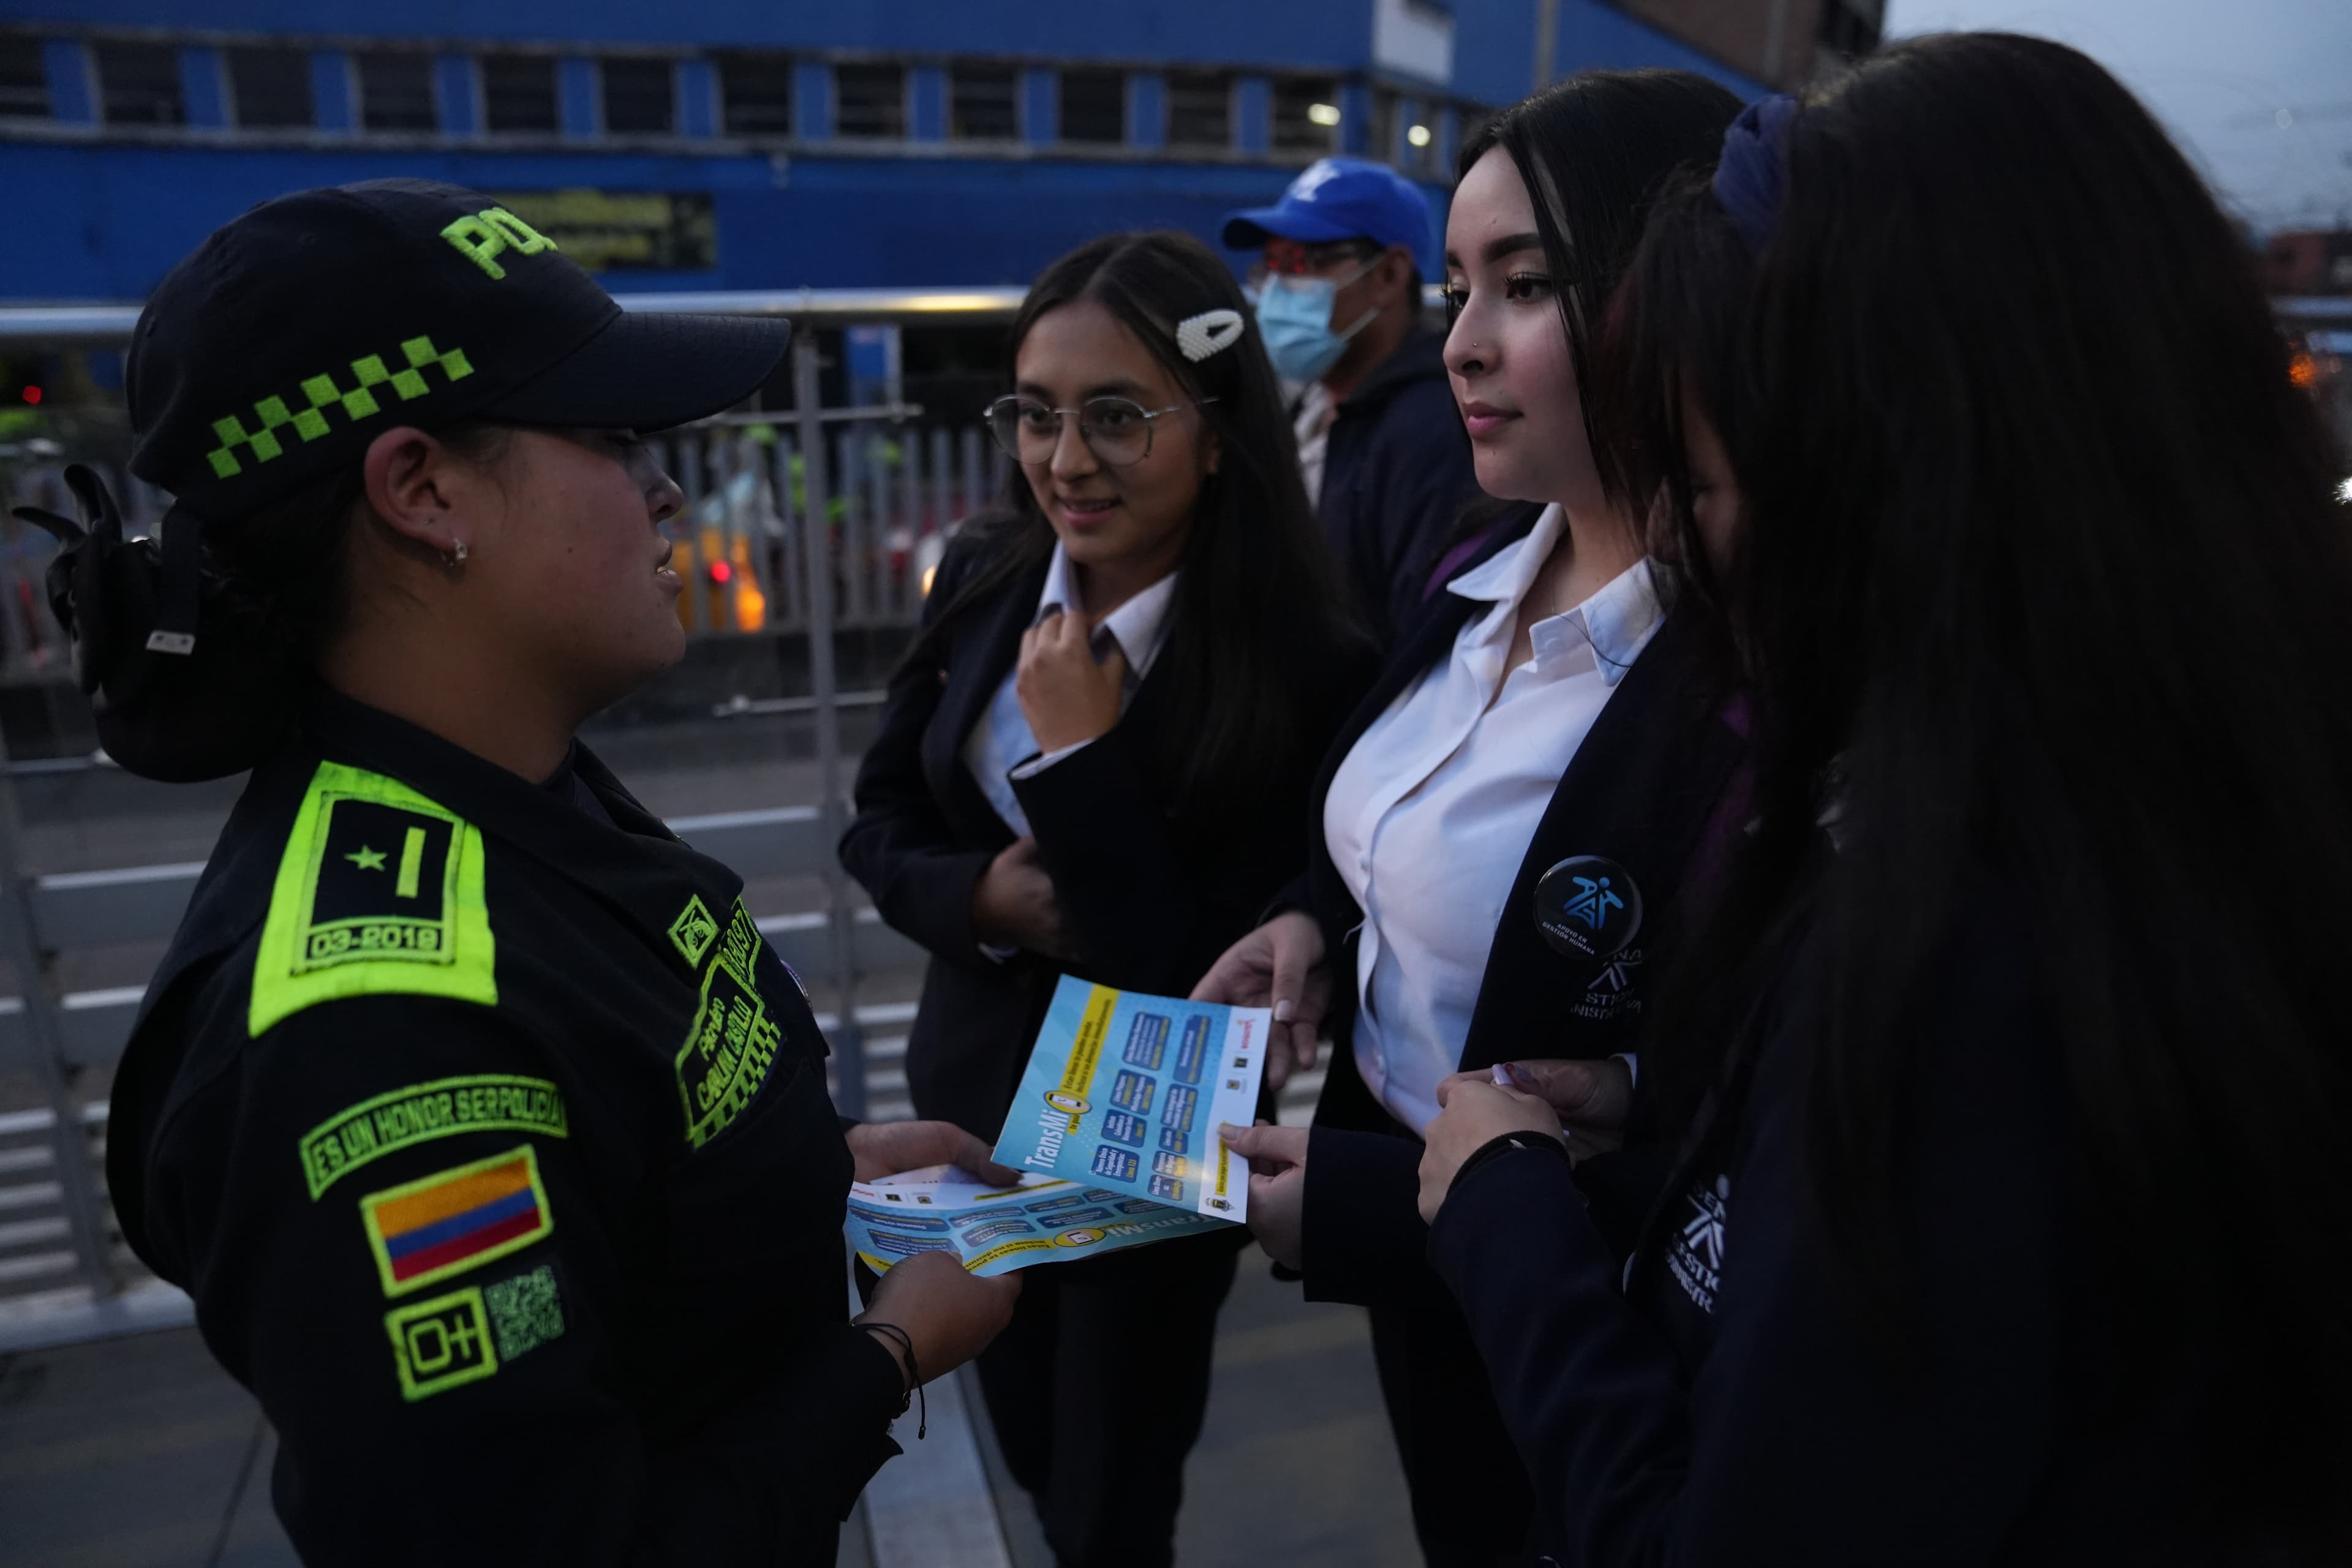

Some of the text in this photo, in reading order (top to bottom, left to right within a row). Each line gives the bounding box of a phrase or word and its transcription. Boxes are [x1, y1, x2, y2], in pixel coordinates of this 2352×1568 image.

[1556, 923, 1578, 938] APOYO
[1569, 938, 1595, 956] HUMANA
[311, 1134, 345, 1181] ES
[340, 1114, 379, 1158] UN
[372, 1091, 456, 1143] HONOR
[1025, 1110, 1069, 1169] TransMi
[407, 1312, 477, 1376] O+
